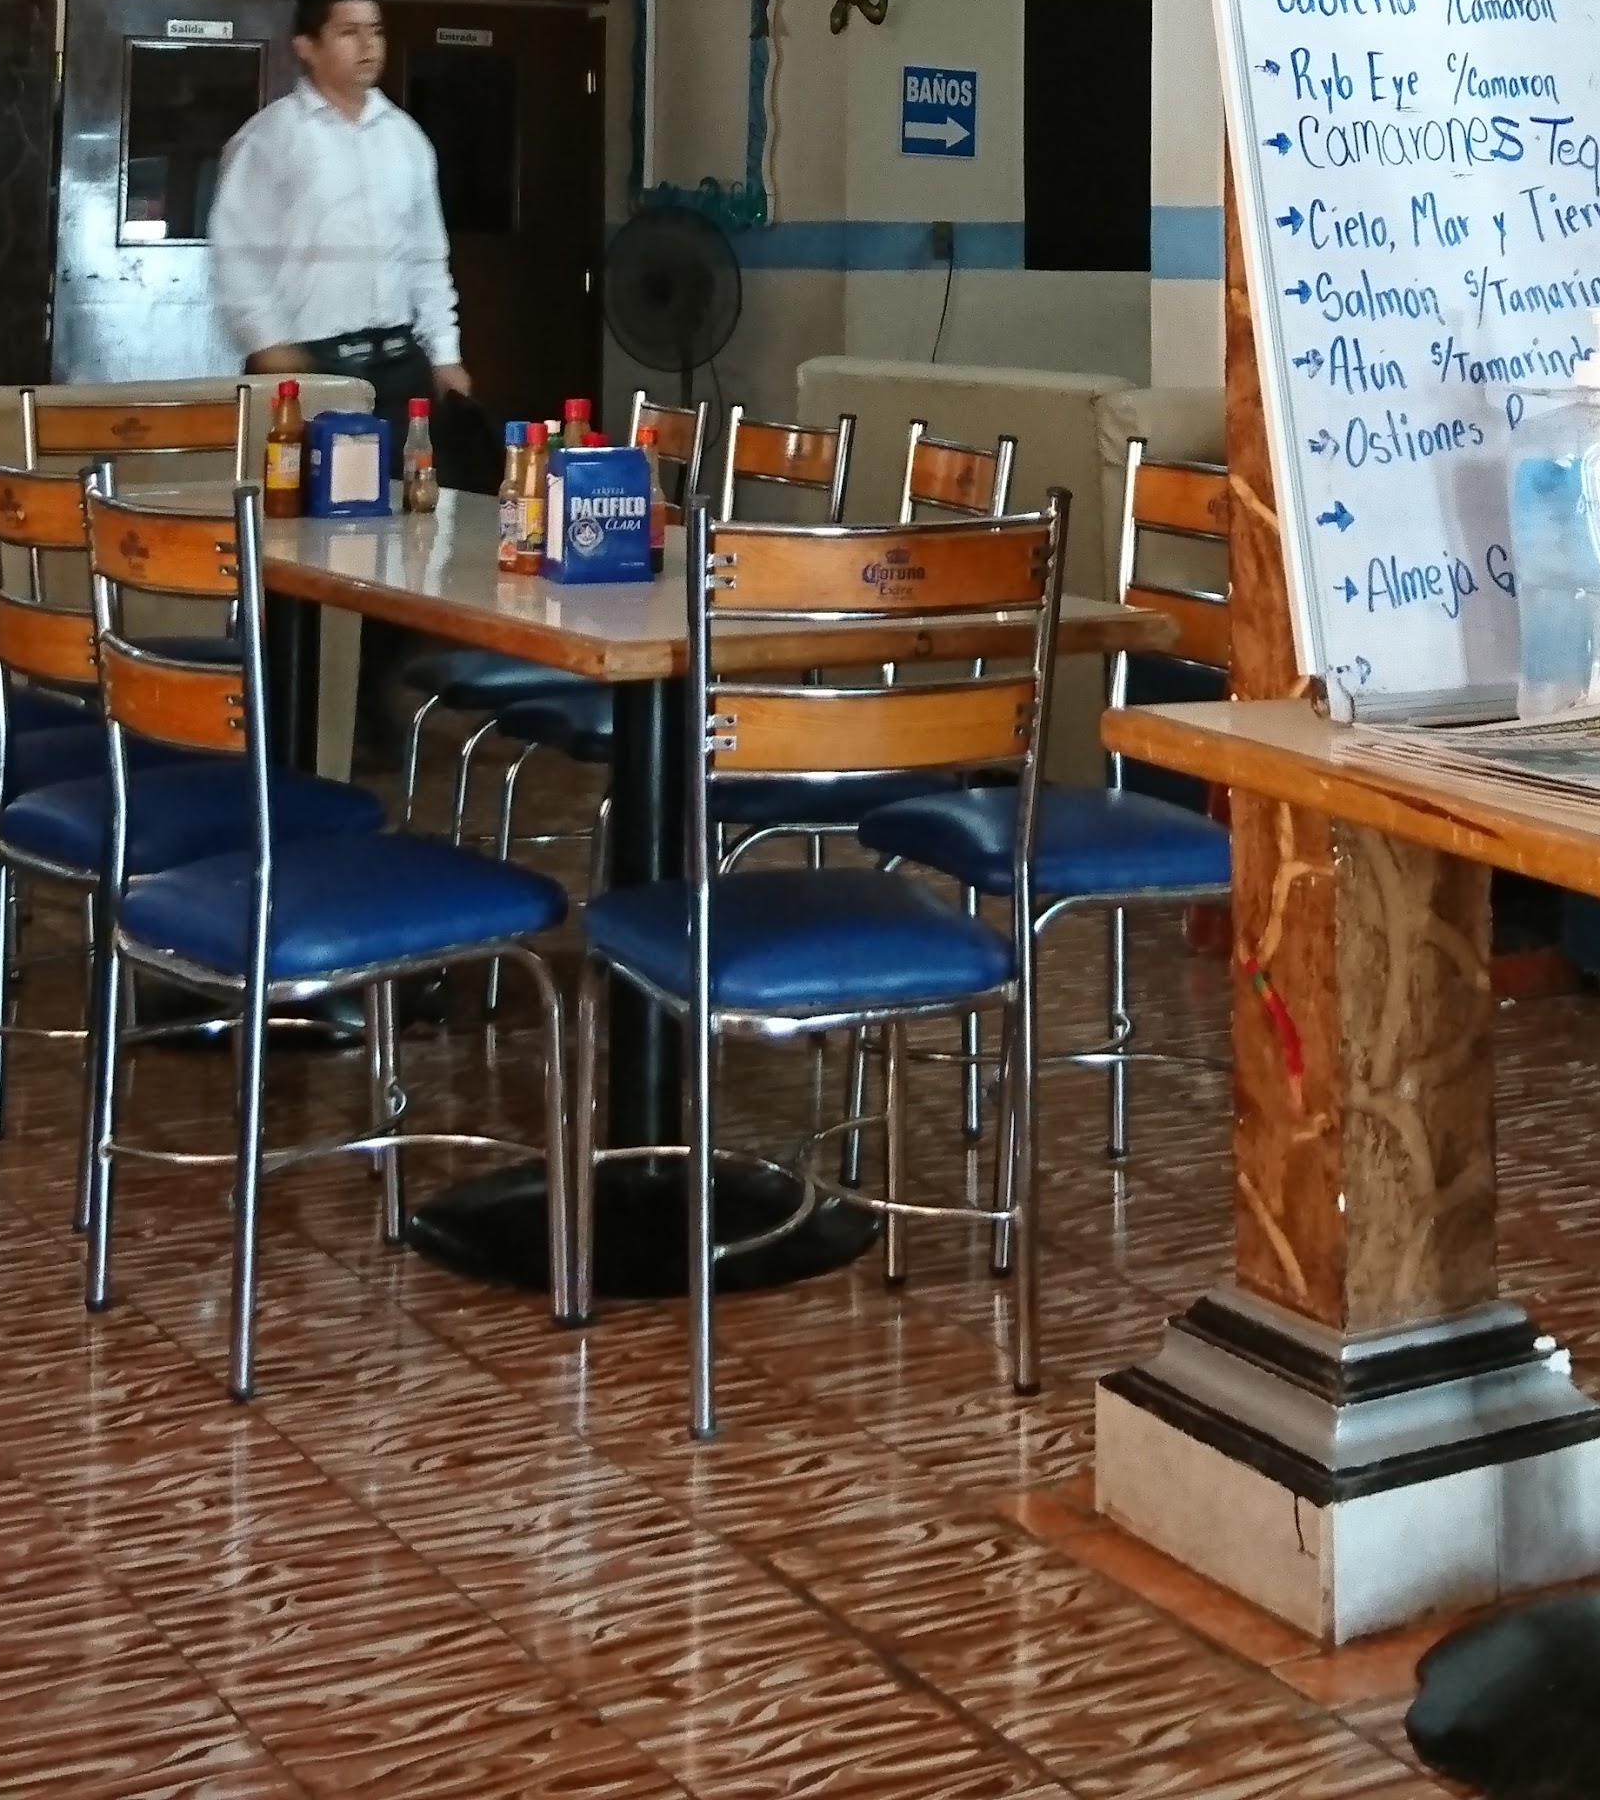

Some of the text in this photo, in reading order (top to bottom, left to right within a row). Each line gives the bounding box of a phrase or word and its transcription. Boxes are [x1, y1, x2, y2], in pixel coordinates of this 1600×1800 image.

[170, 24, 204, 34] Salida
[439, 31, 477, 42] Entrada
[906, 73, 972, 106] BAÑOS
[1367, 51, 1418, 111] Eye
[1411, 192, 1470, 247] Mar
[1345, 410, 1484, 467] Ostiones
[570, 496, 646, 520] PACIFICO
[605, 518, 641, 532] CLARA
[862, 563, 925, 585] Corona
[1368, 551, 1478, 619] Almeja
